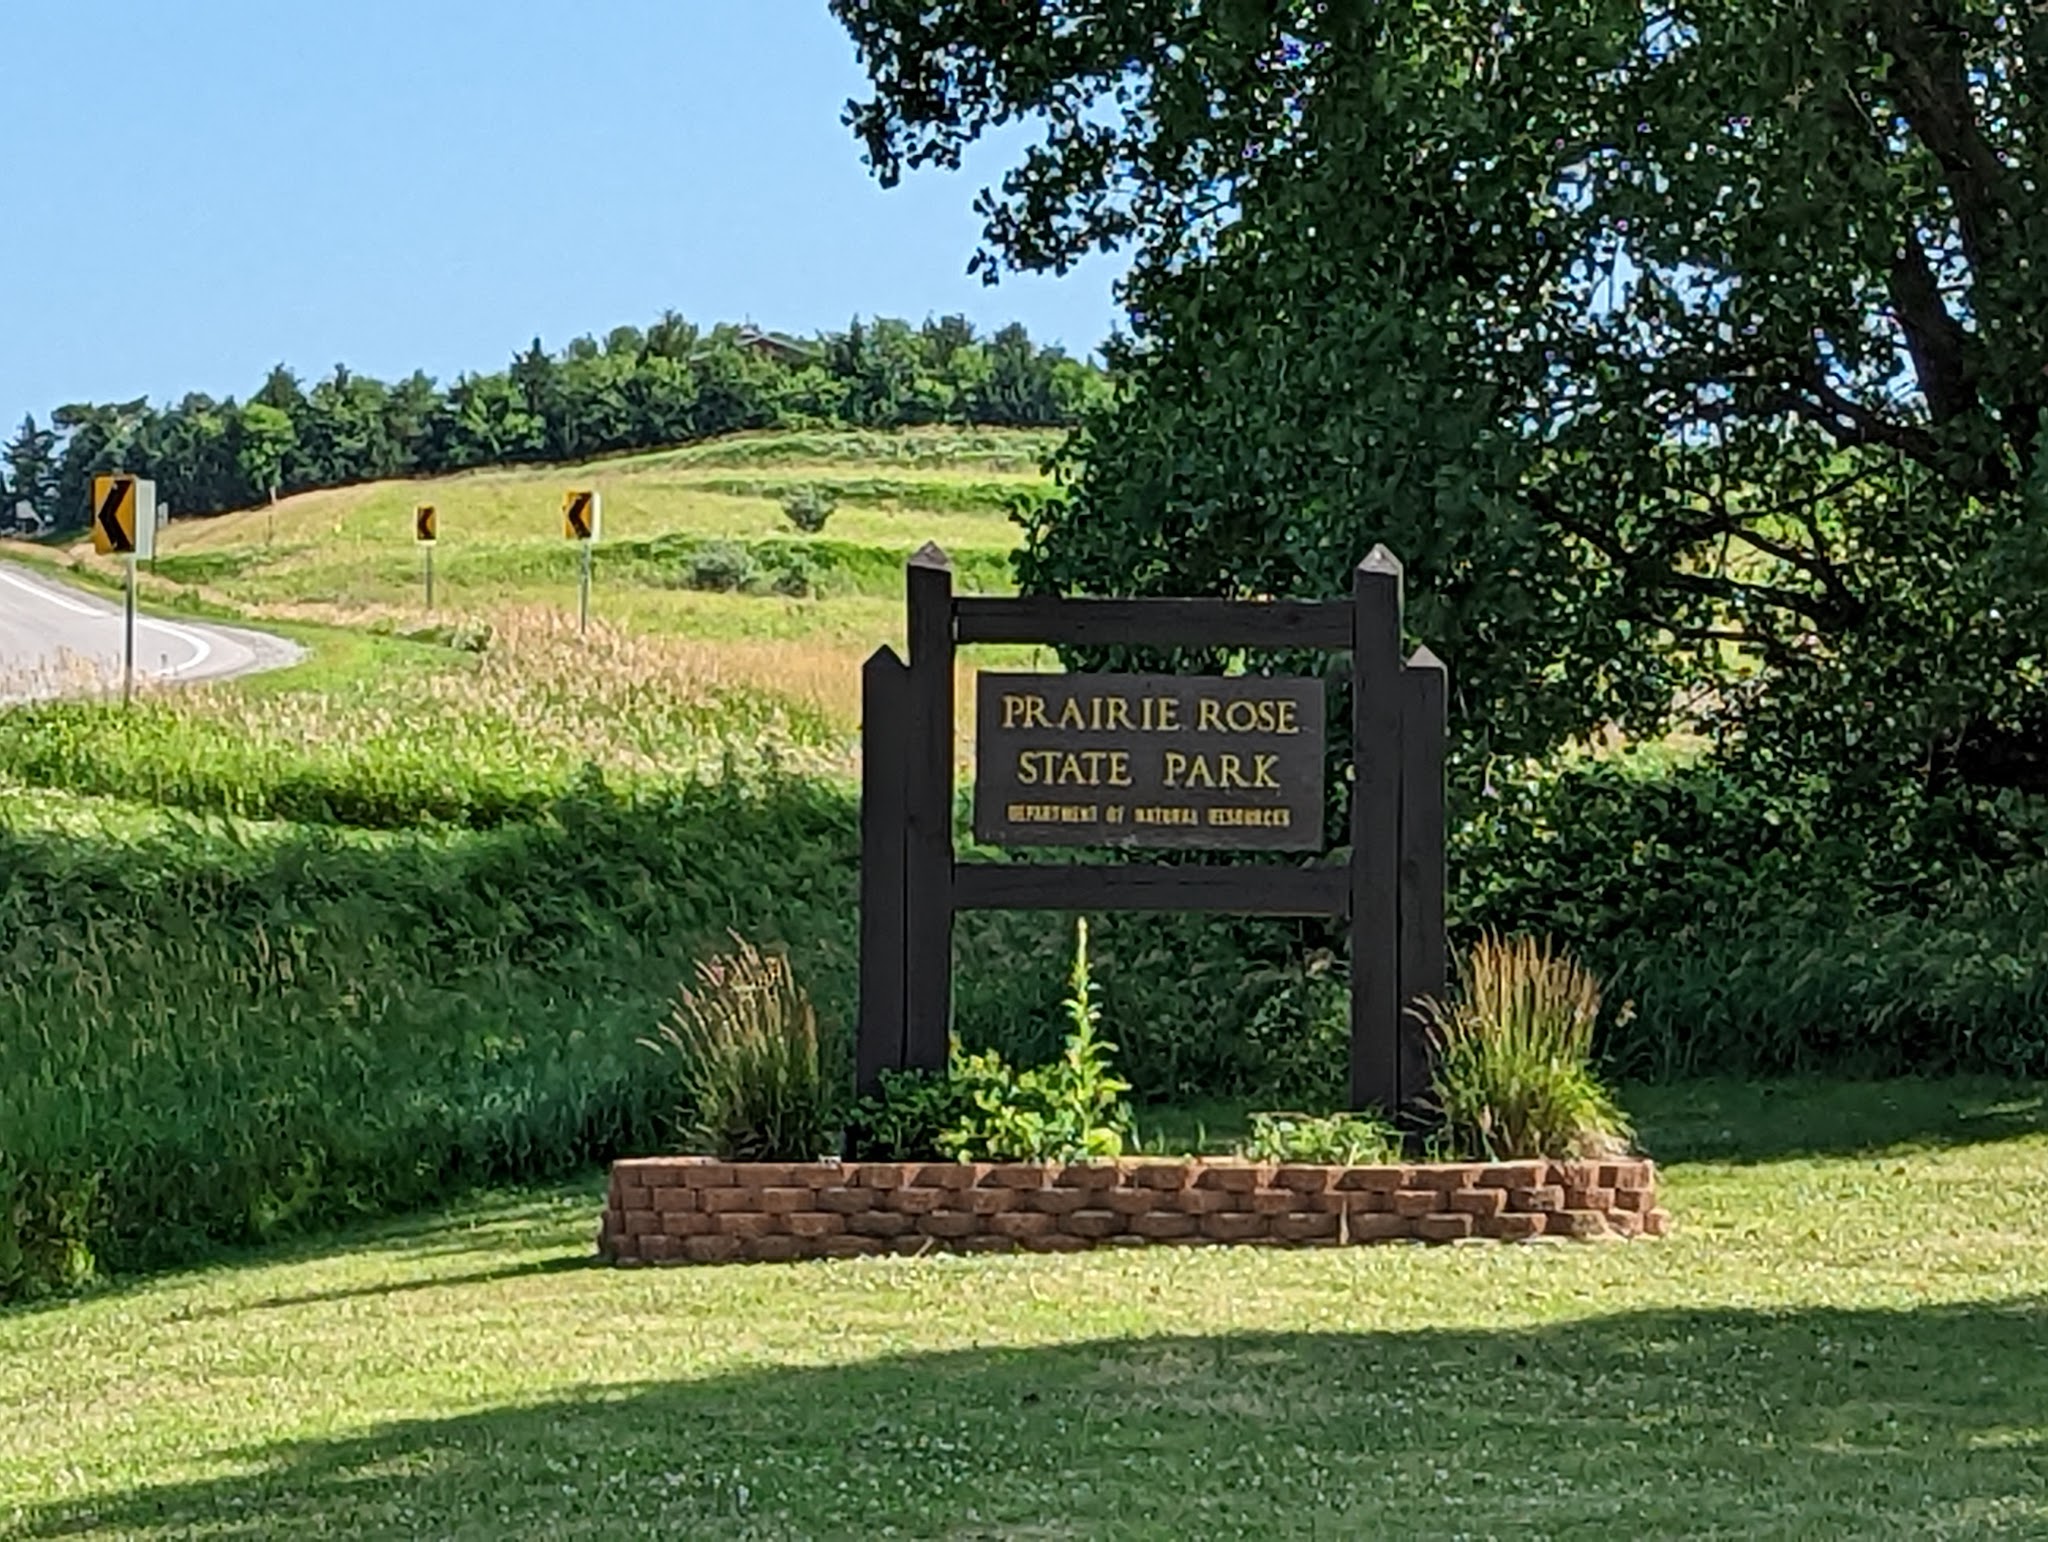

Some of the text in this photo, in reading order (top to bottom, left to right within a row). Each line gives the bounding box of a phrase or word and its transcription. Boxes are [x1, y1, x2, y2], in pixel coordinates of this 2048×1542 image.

[1002, 695, 1300, 734] PRAIRIE ROSE
[1017, 750, 1281, 788] STATE PARK
[1007, 805, 1291, 827] DEPARTMENT OF NATURAL RESOURCES
